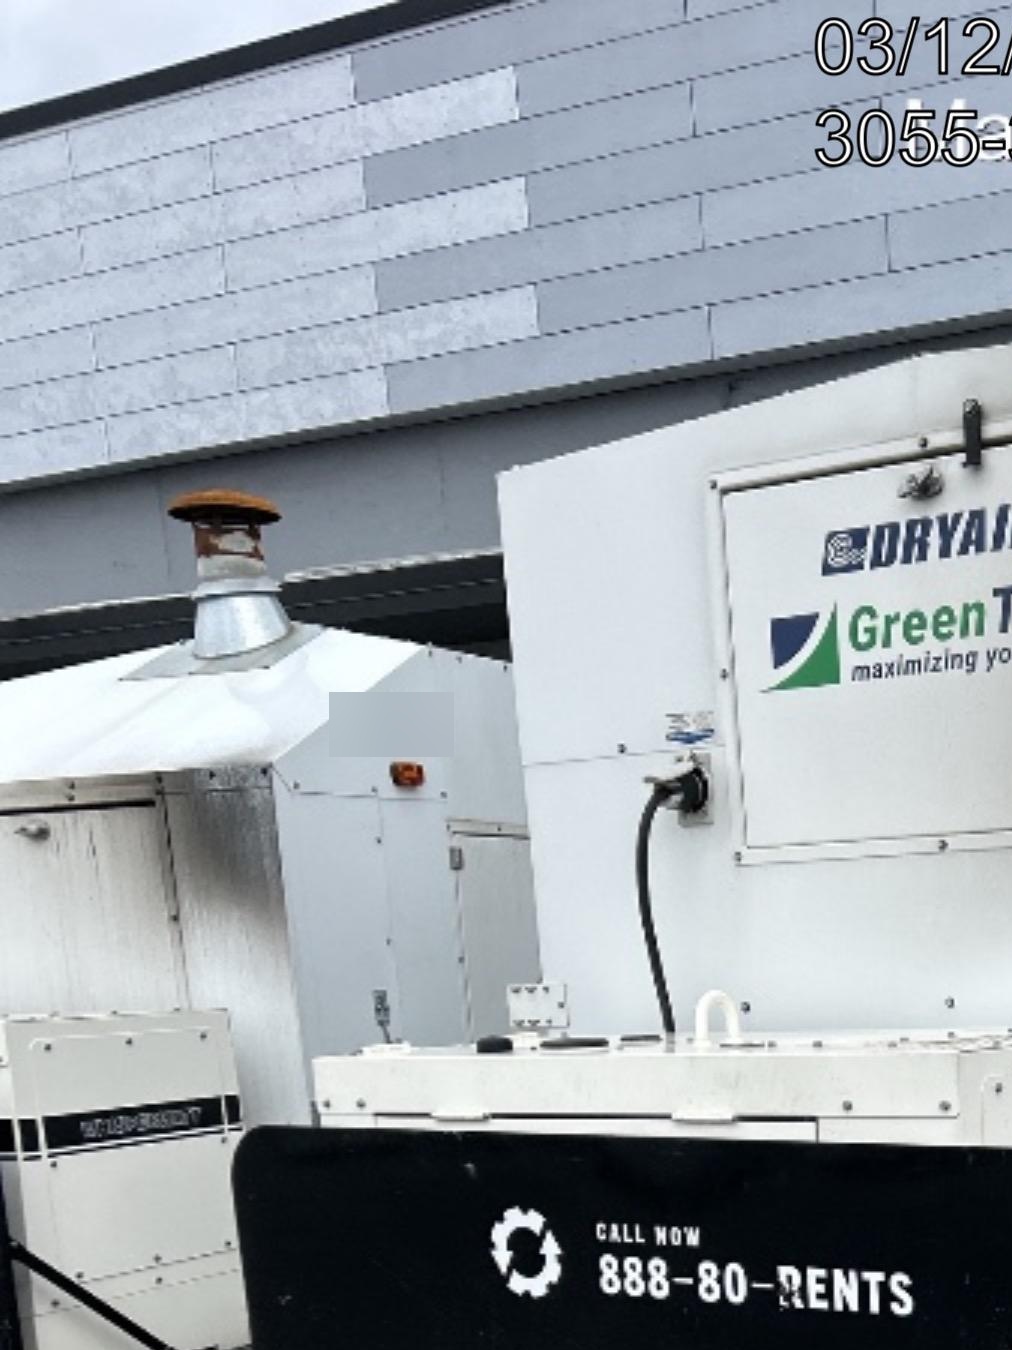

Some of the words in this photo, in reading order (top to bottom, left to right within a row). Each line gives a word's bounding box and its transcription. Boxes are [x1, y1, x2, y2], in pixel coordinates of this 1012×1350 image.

[852, 647, 979, 682] maximizing
[595, 1222, 645, 1244] CALL
[655, 1225, 700, 1247] NOW
[598, 1253, 915, 1317] 888-80-RENTS
